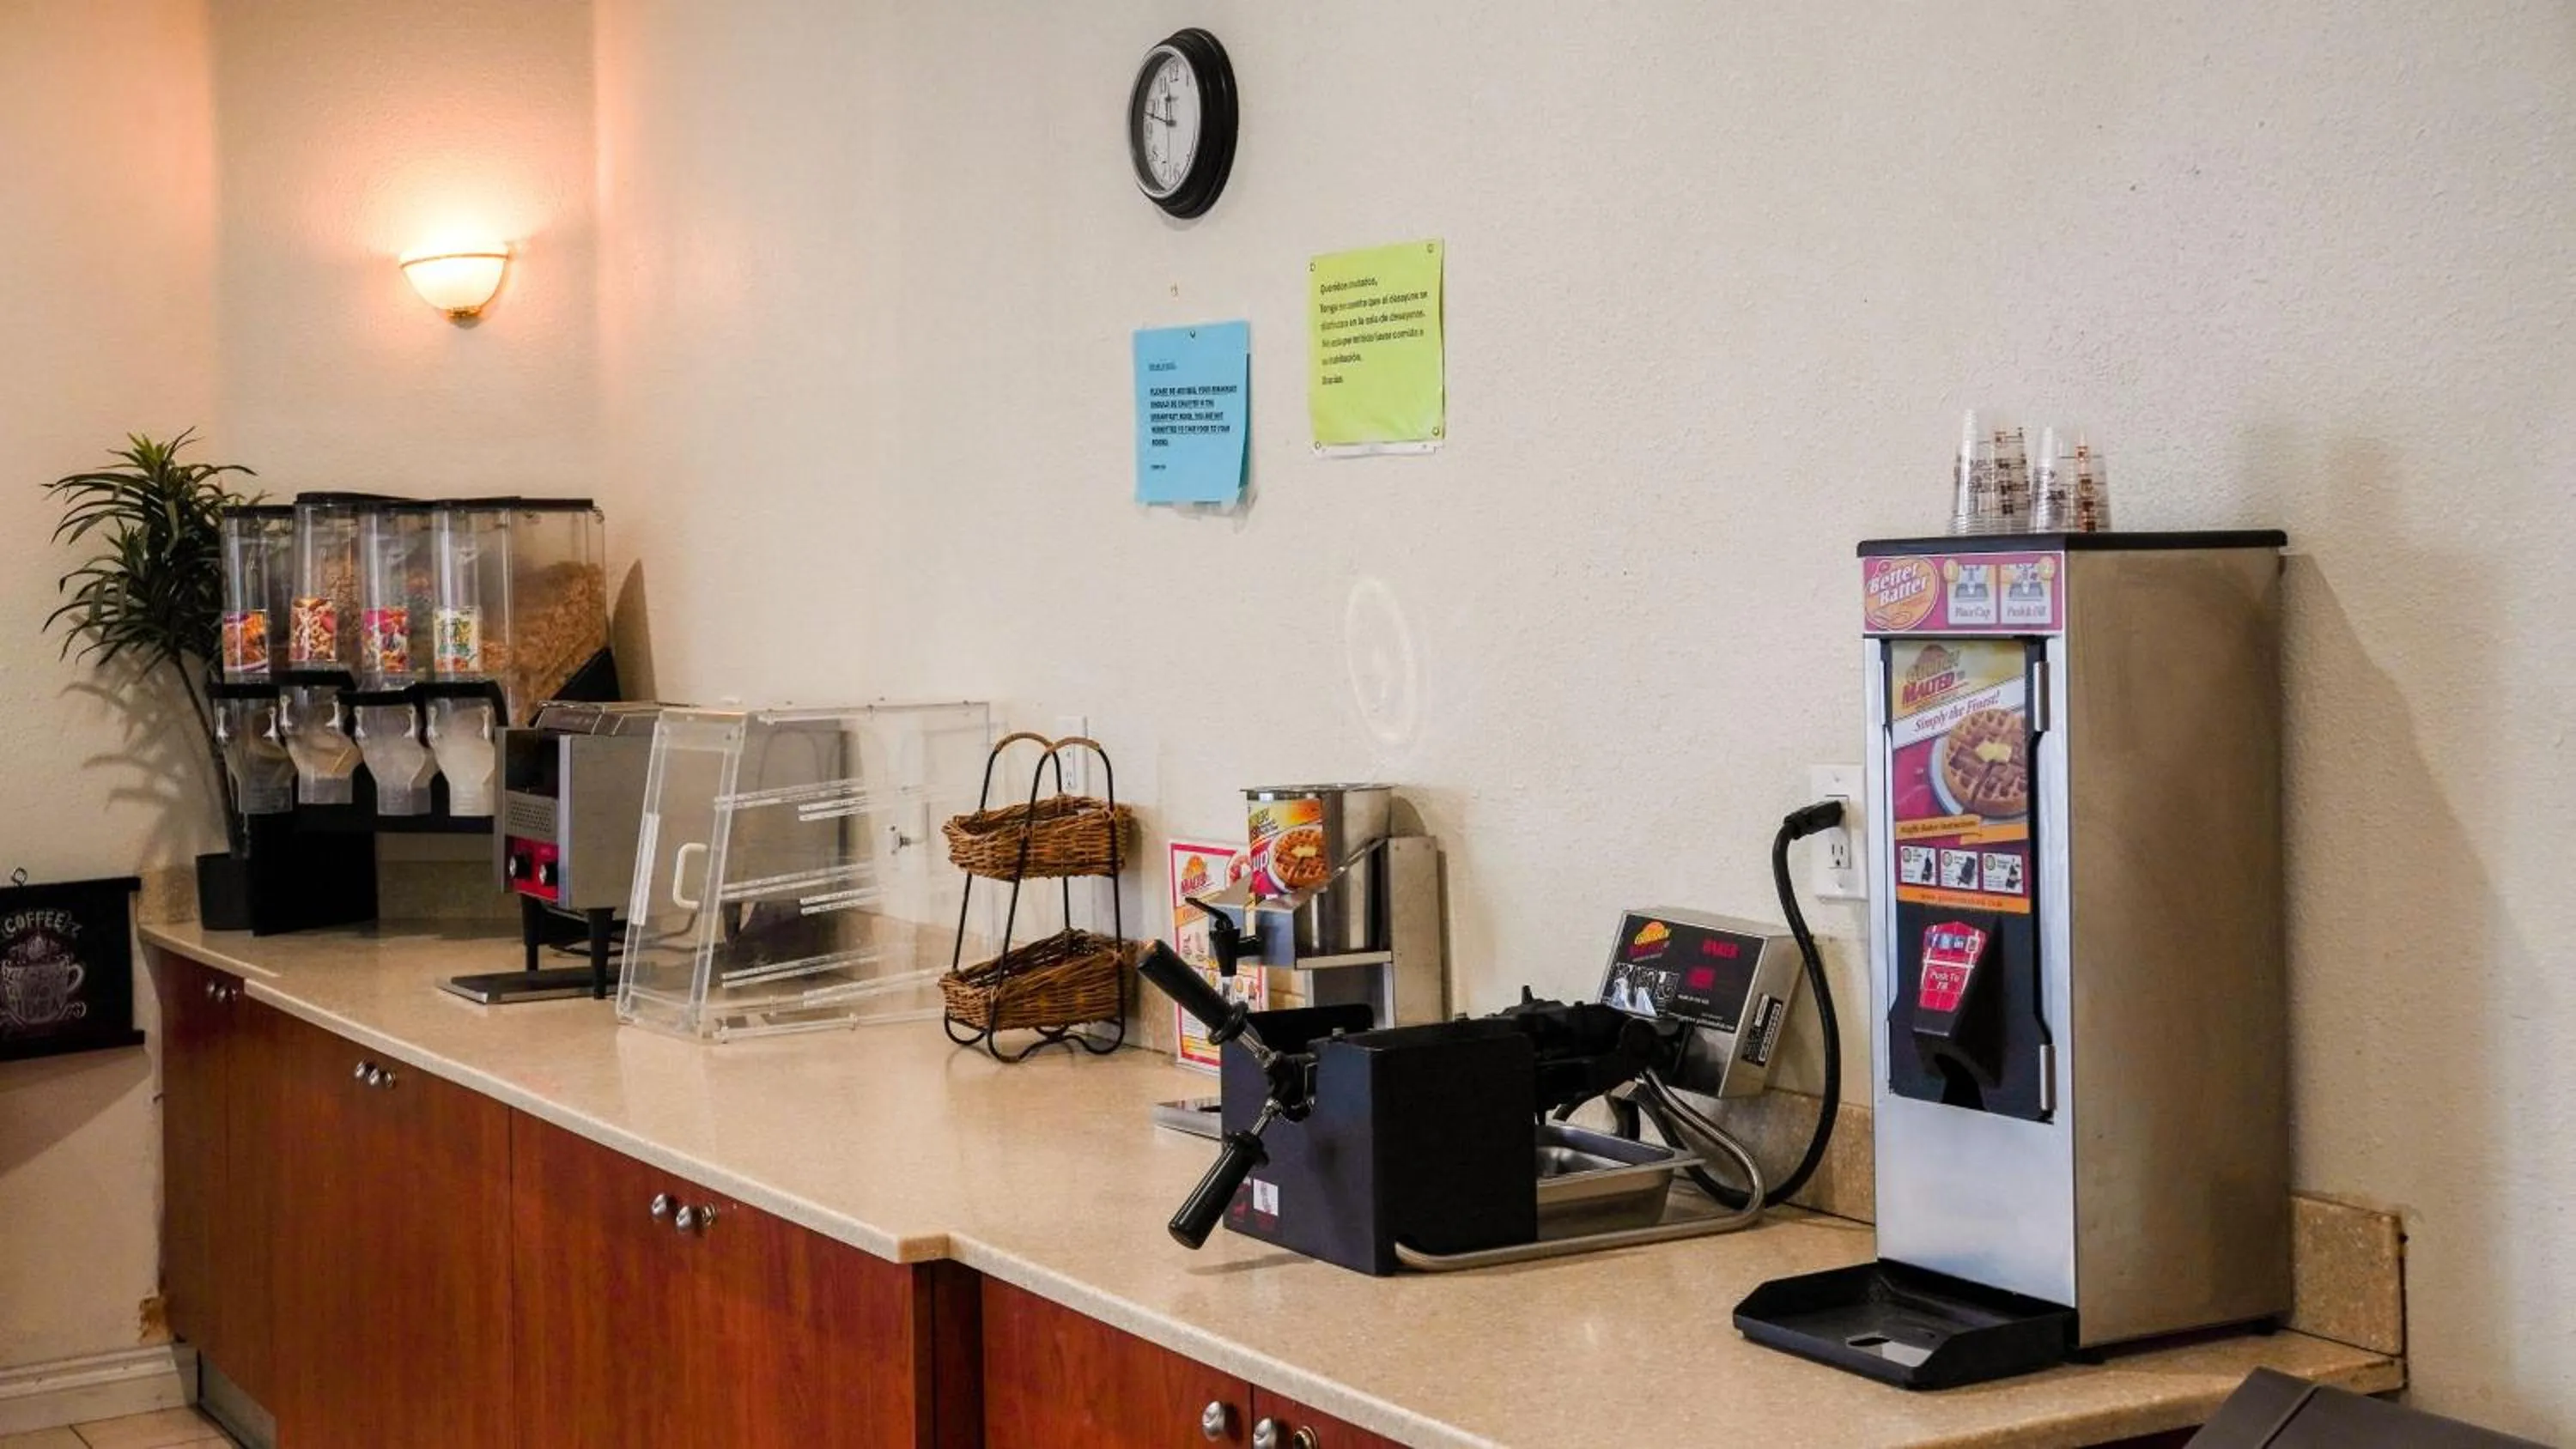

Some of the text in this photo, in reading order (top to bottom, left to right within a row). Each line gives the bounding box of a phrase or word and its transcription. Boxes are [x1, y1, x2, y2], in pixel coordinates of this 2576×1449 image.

[1868, 563, 1918, 594] Better
[1880, 577, 1928, 606] Batter
[1902, 670, 1955, 708] MALTED
[1915, 710, 1948, 731] Simply
[3, 909, 67, 934] COFFEE
